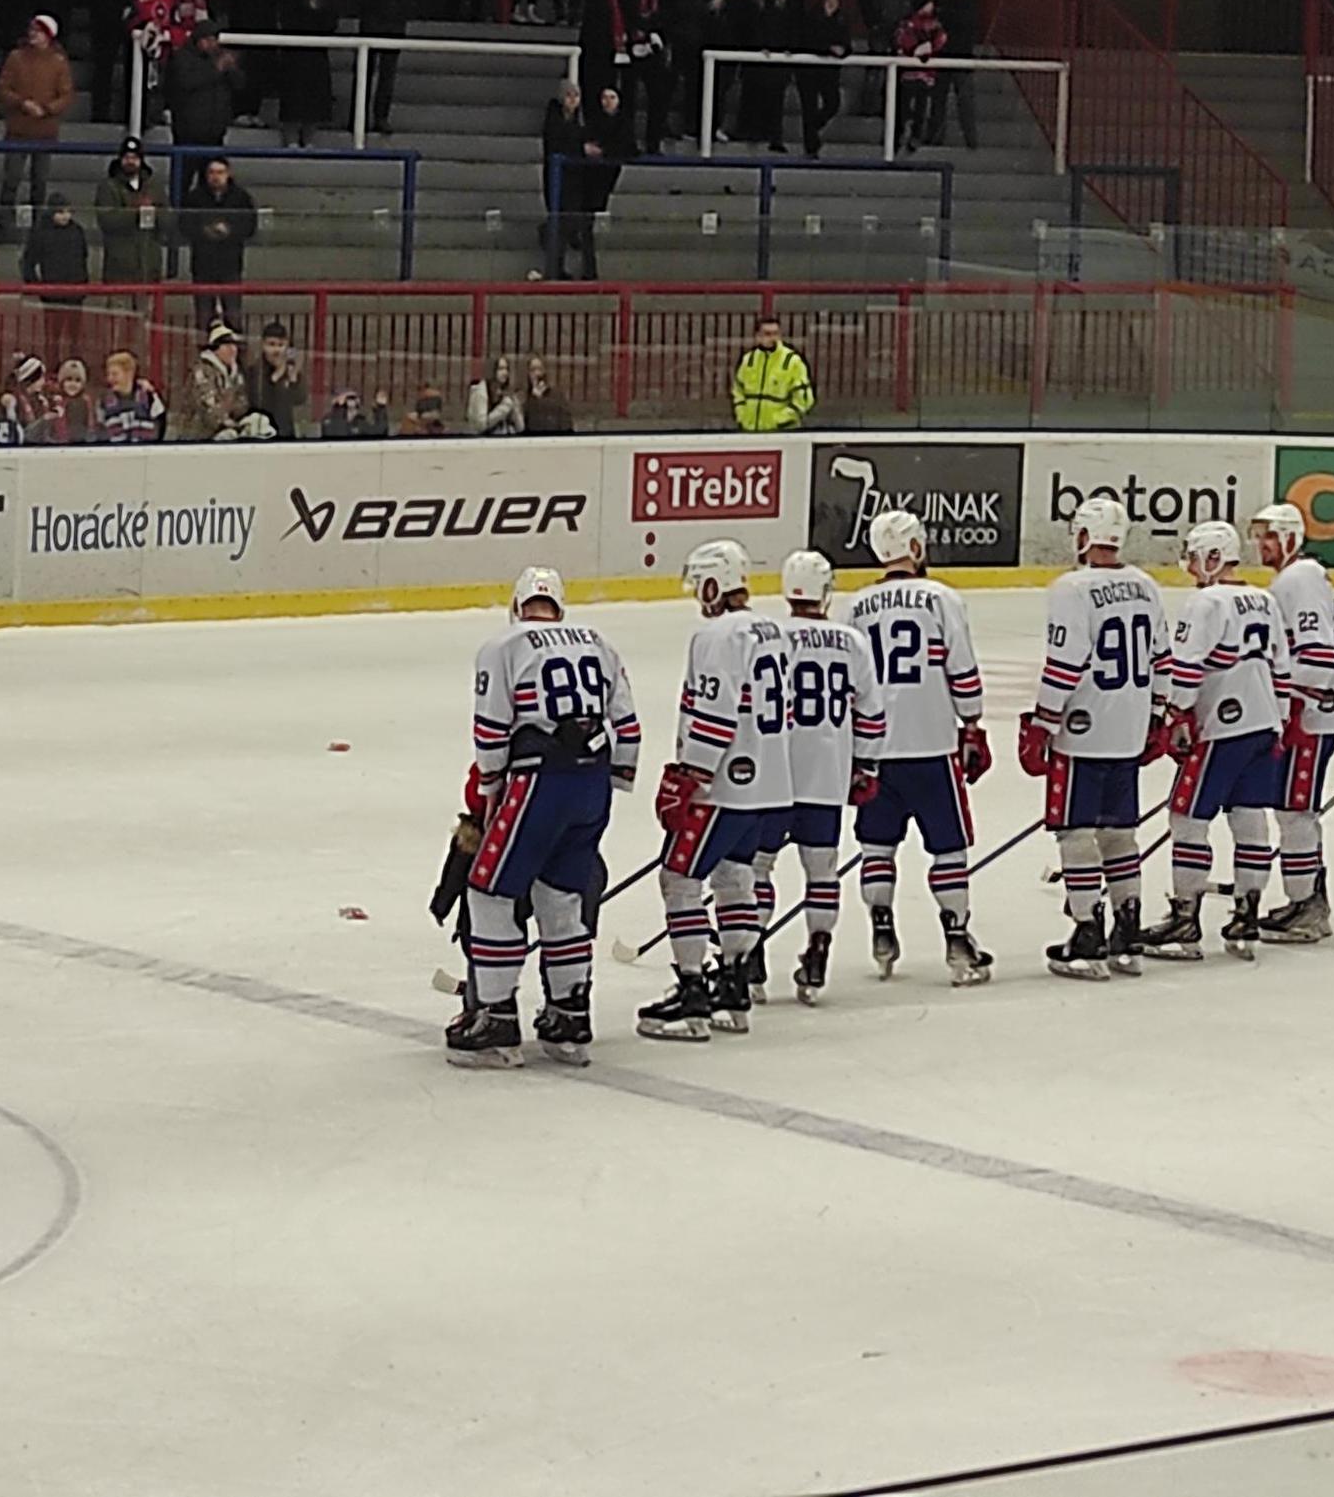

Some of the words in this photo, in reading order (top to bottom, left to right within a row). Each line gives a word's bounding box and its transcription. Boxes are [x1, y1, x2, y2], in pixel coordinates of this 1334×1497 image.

[667, 463, 774, 509] Třebíč
[921, 491, 1001, 523] JINAK
[30, 501, 148, 554] Horácké
[156, 497, 255, 562] noviny
[954, 528, 999, 545] FOOD
[867, 619, 922, 686] 12
[1092, 613, 1152, 691] 90
[1297, 611, 1320, 632] 22
[541, 655, 607, 722] 89
[792, 660, 850, 729] 88
